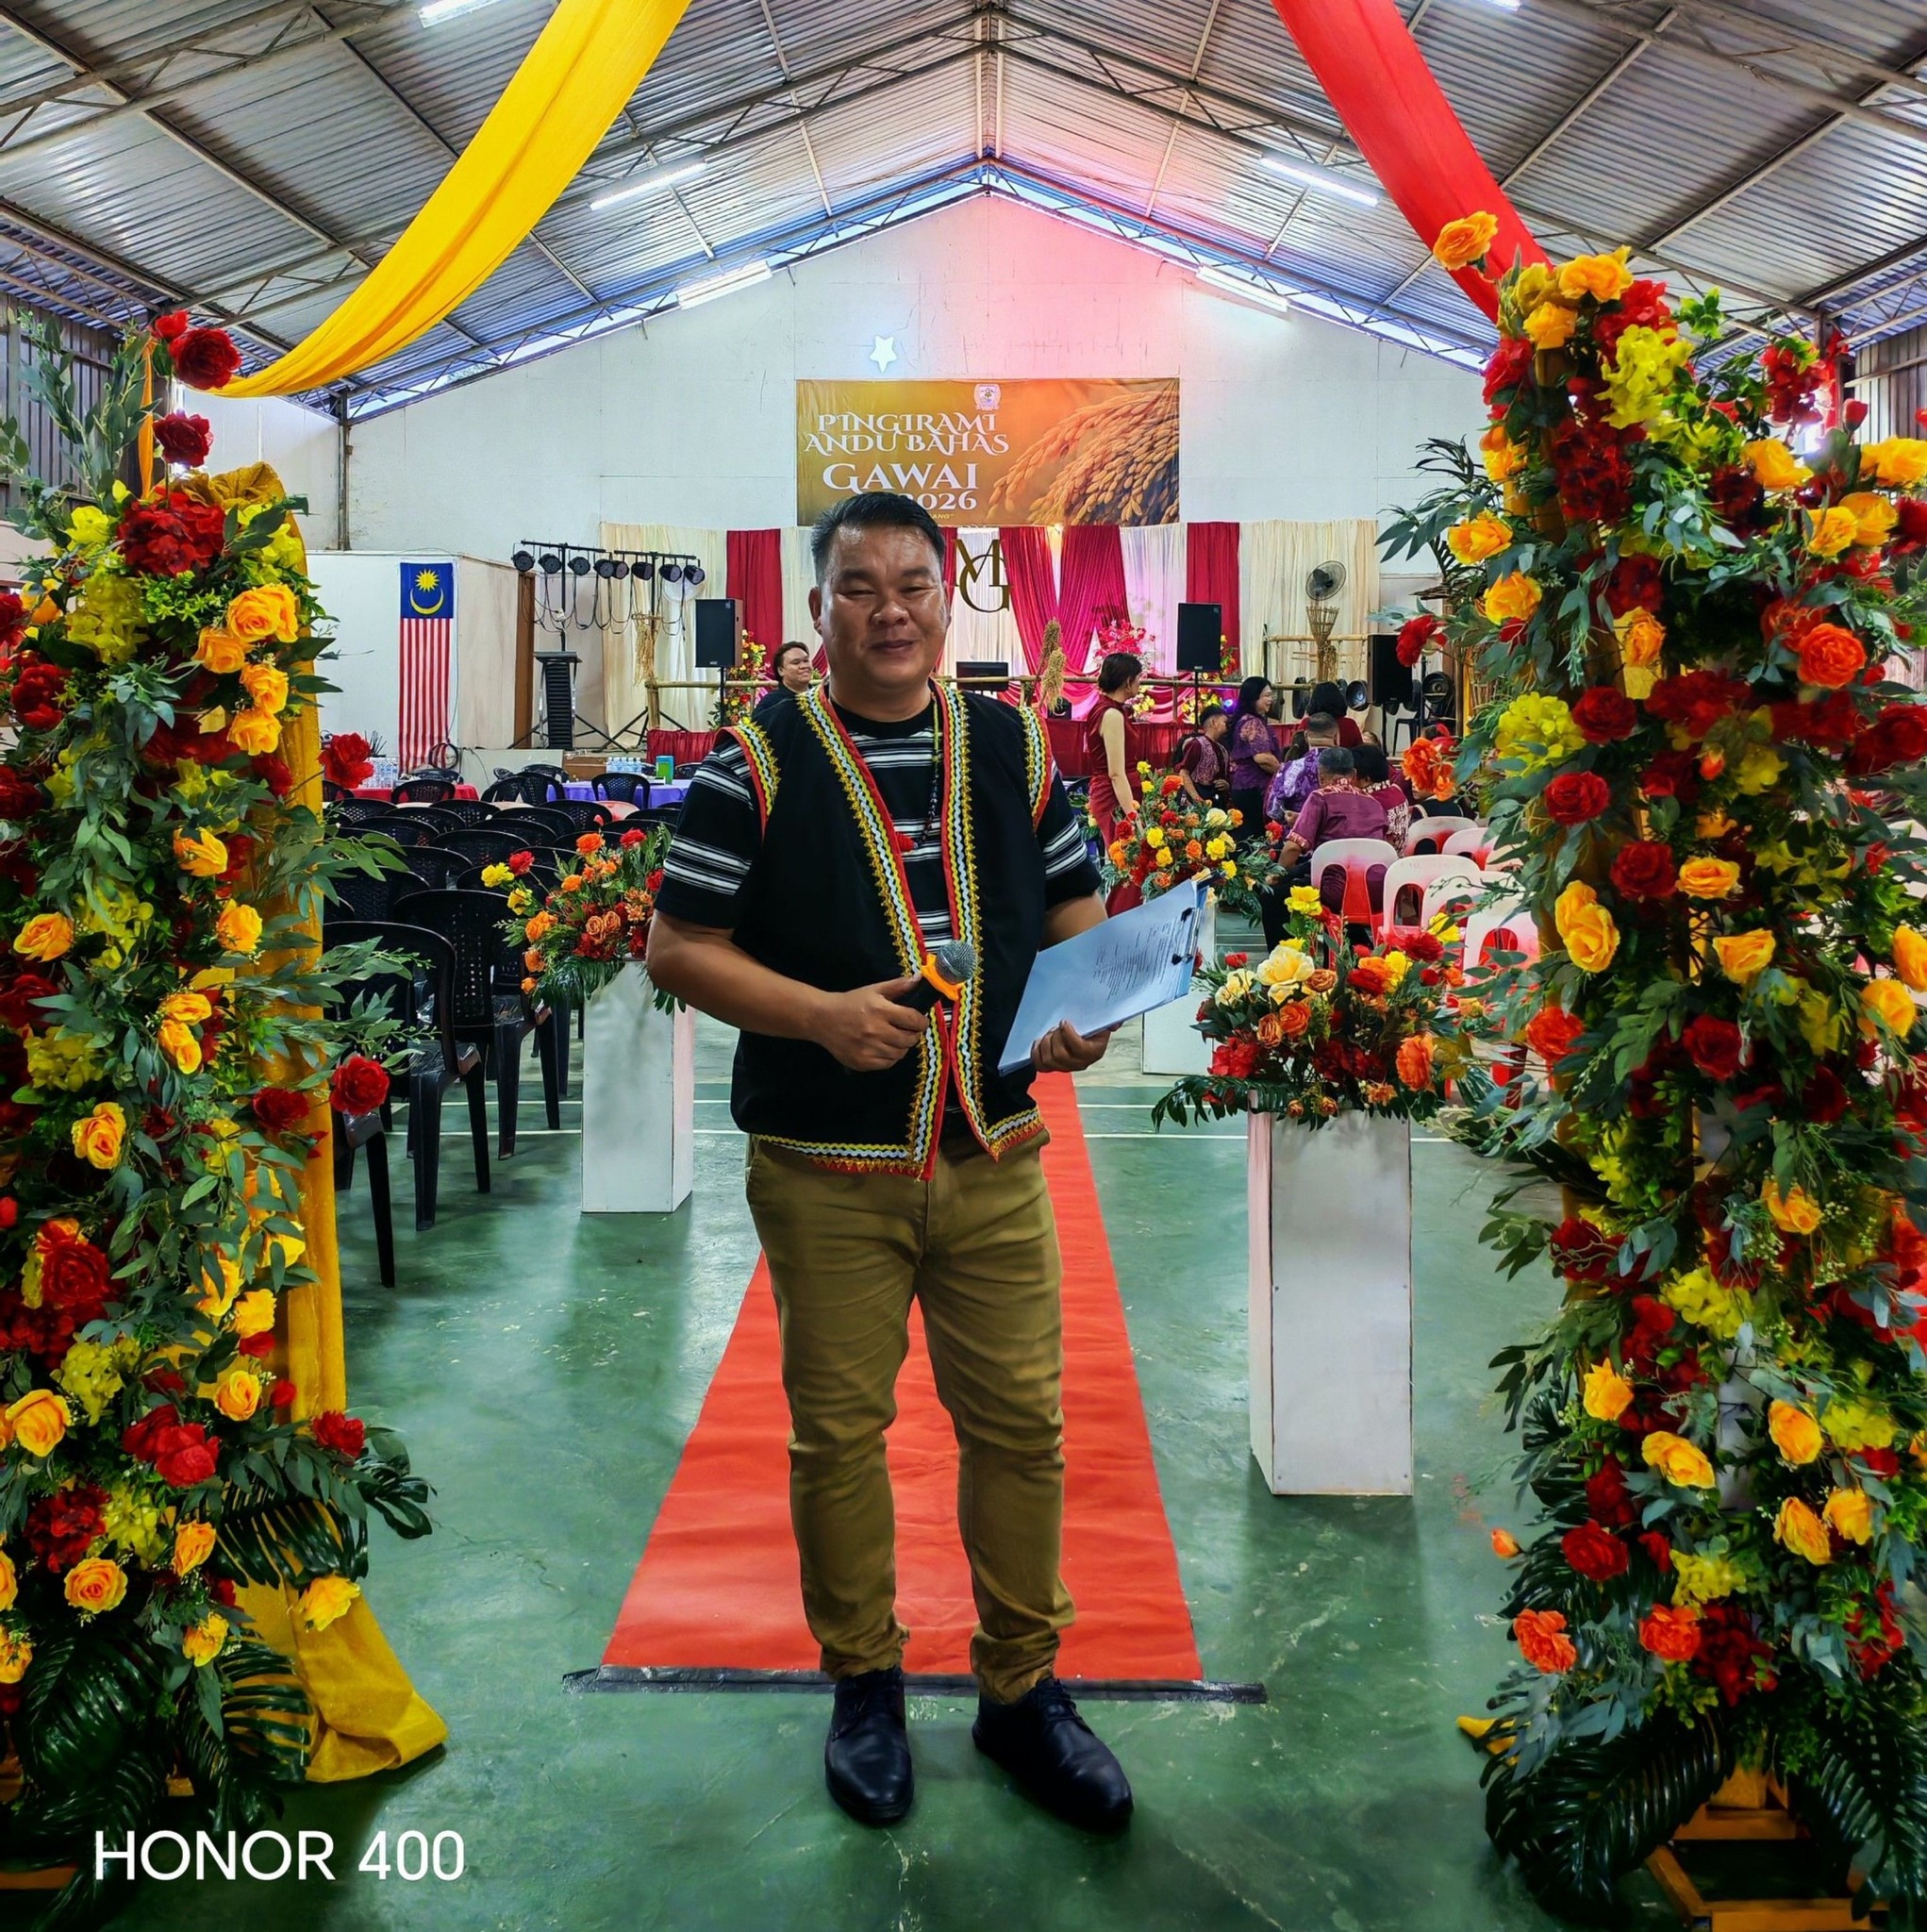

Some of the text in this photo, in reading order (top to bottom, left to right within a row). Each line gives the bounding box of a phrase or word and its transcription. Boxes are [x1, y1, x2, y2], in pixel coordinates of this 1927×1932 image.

[818, 412, 998, 436] PINGIRAMI
[805, 433, 1009, 456] ANDU BAHAS
[822, 463, 979, 493] GAWAI
